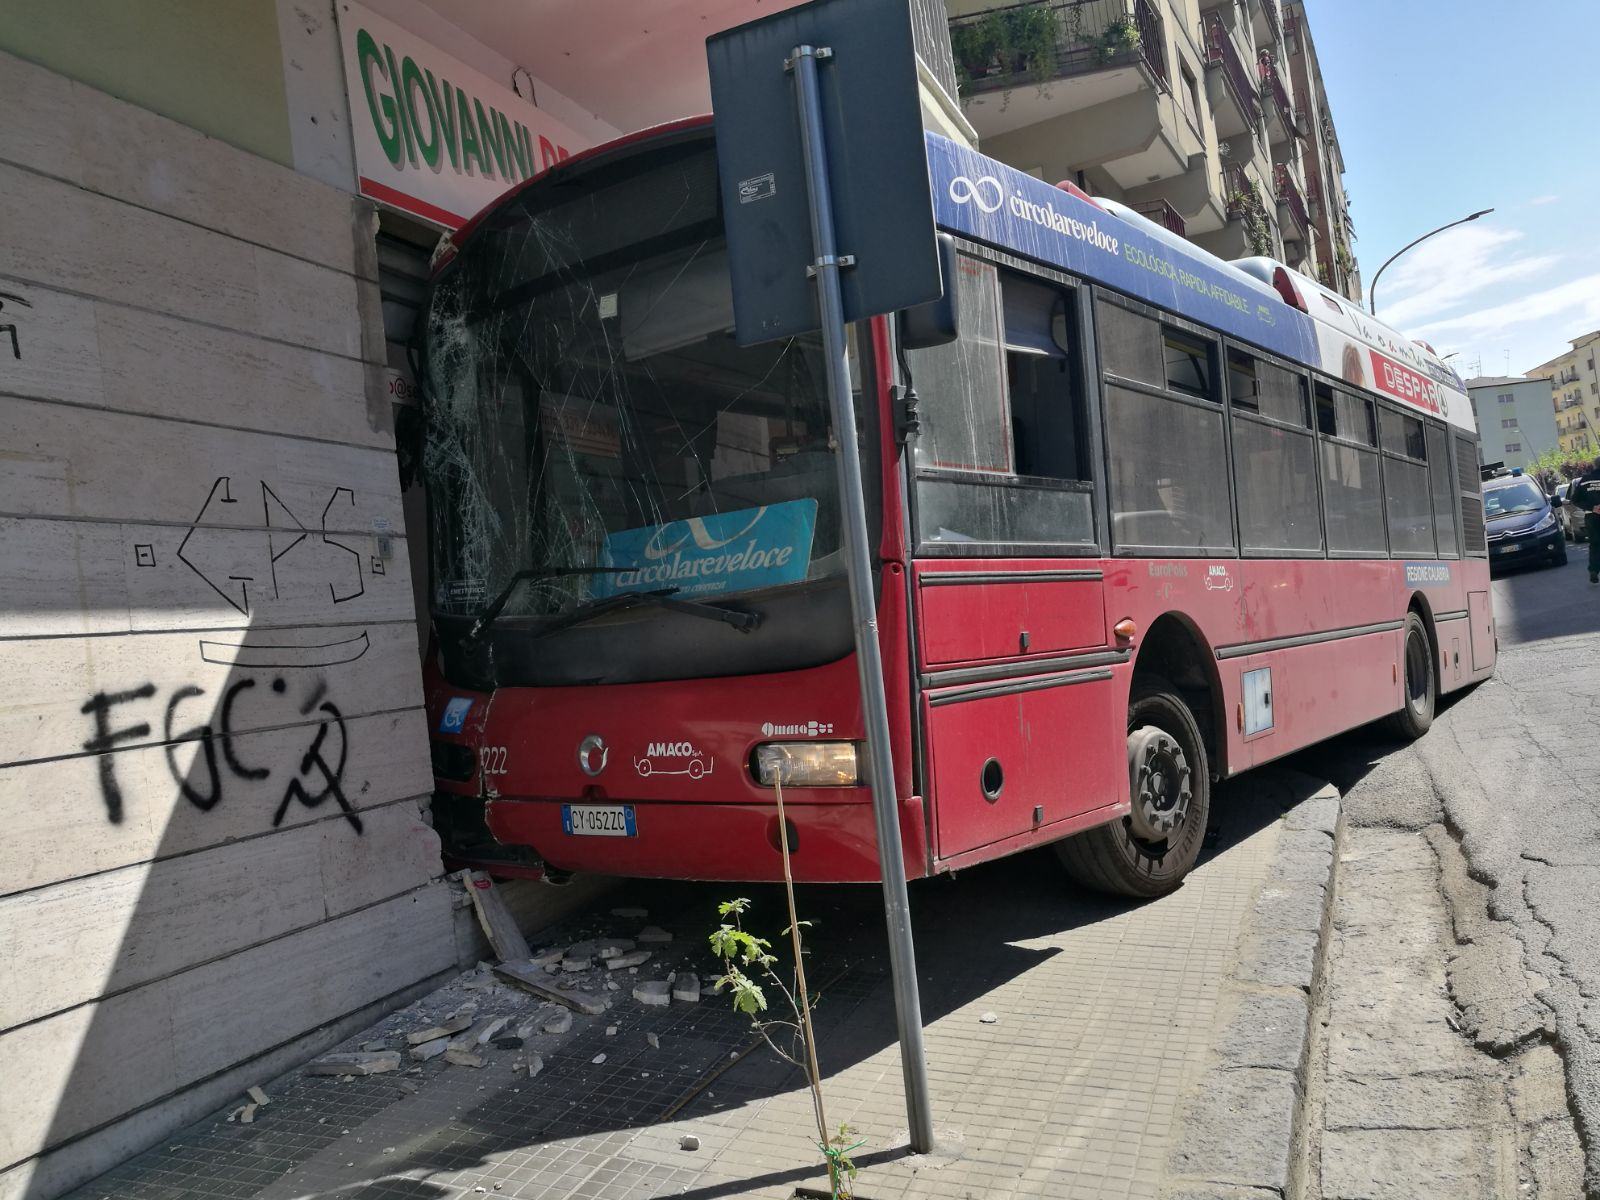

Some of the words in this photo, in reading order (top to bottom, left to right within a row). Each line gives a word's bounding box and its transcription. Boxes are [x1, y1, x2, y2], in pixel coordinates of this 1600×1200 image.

[357, 28, 537, 182] GIOVANNI
[1010, 190, 1119, 256] circolareveloce
[1383, 362, 1438, 406] DESPAR
[616, 539, 793, 588] circolareveloce
[1208, 565, 1226, 577] AMACO
[646, 742, 692, 757] AMACO
